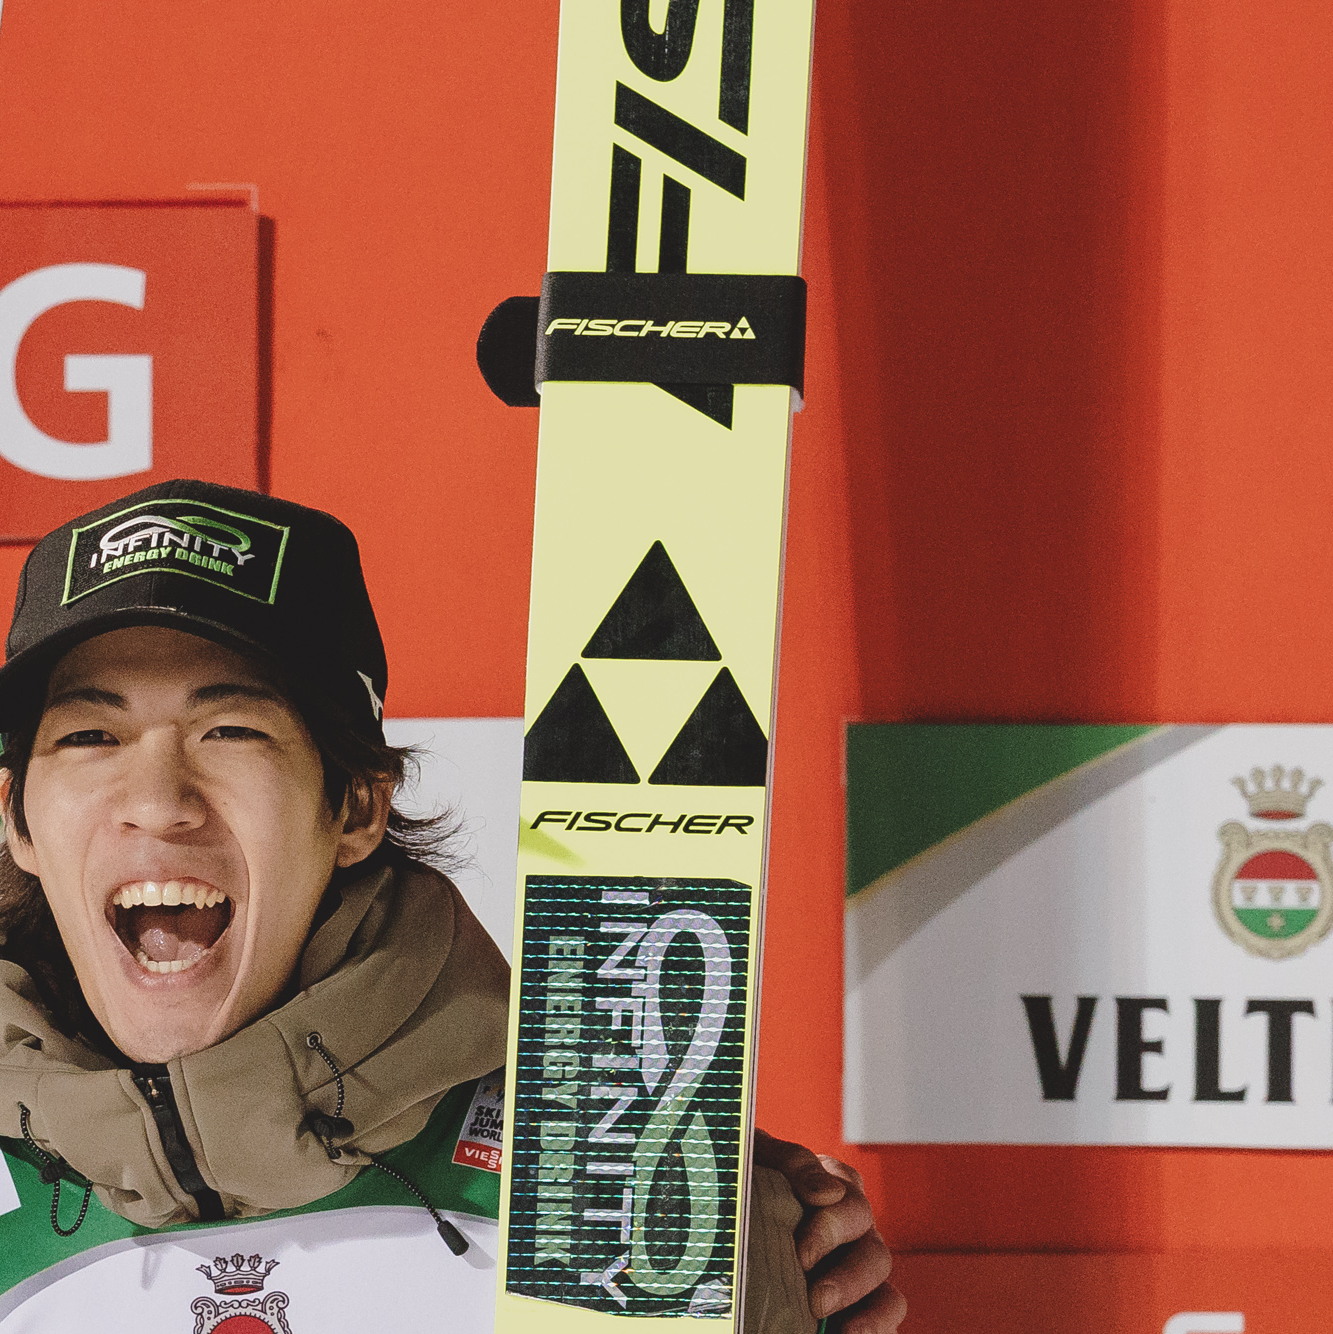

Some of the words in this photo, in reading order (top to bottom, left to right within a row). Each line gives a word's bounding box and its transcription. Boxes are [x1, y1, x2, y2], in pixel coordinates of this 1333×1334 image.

[545, 318, 731, 340] FISCHER
[90, 529, 256, 568] INFINITY
[103, 546, 173, 573] ENERGY
[174, 547, 235, 577] DRINK
[530, 811, 755, 837] FISCHER
[542, 935, 585, 1109] ENERGY
[475, 1105, 501, 1119] SKI
[464, 1147, 503, 1169] VIESS
[534, 1119, 576, 1266] DRINK
